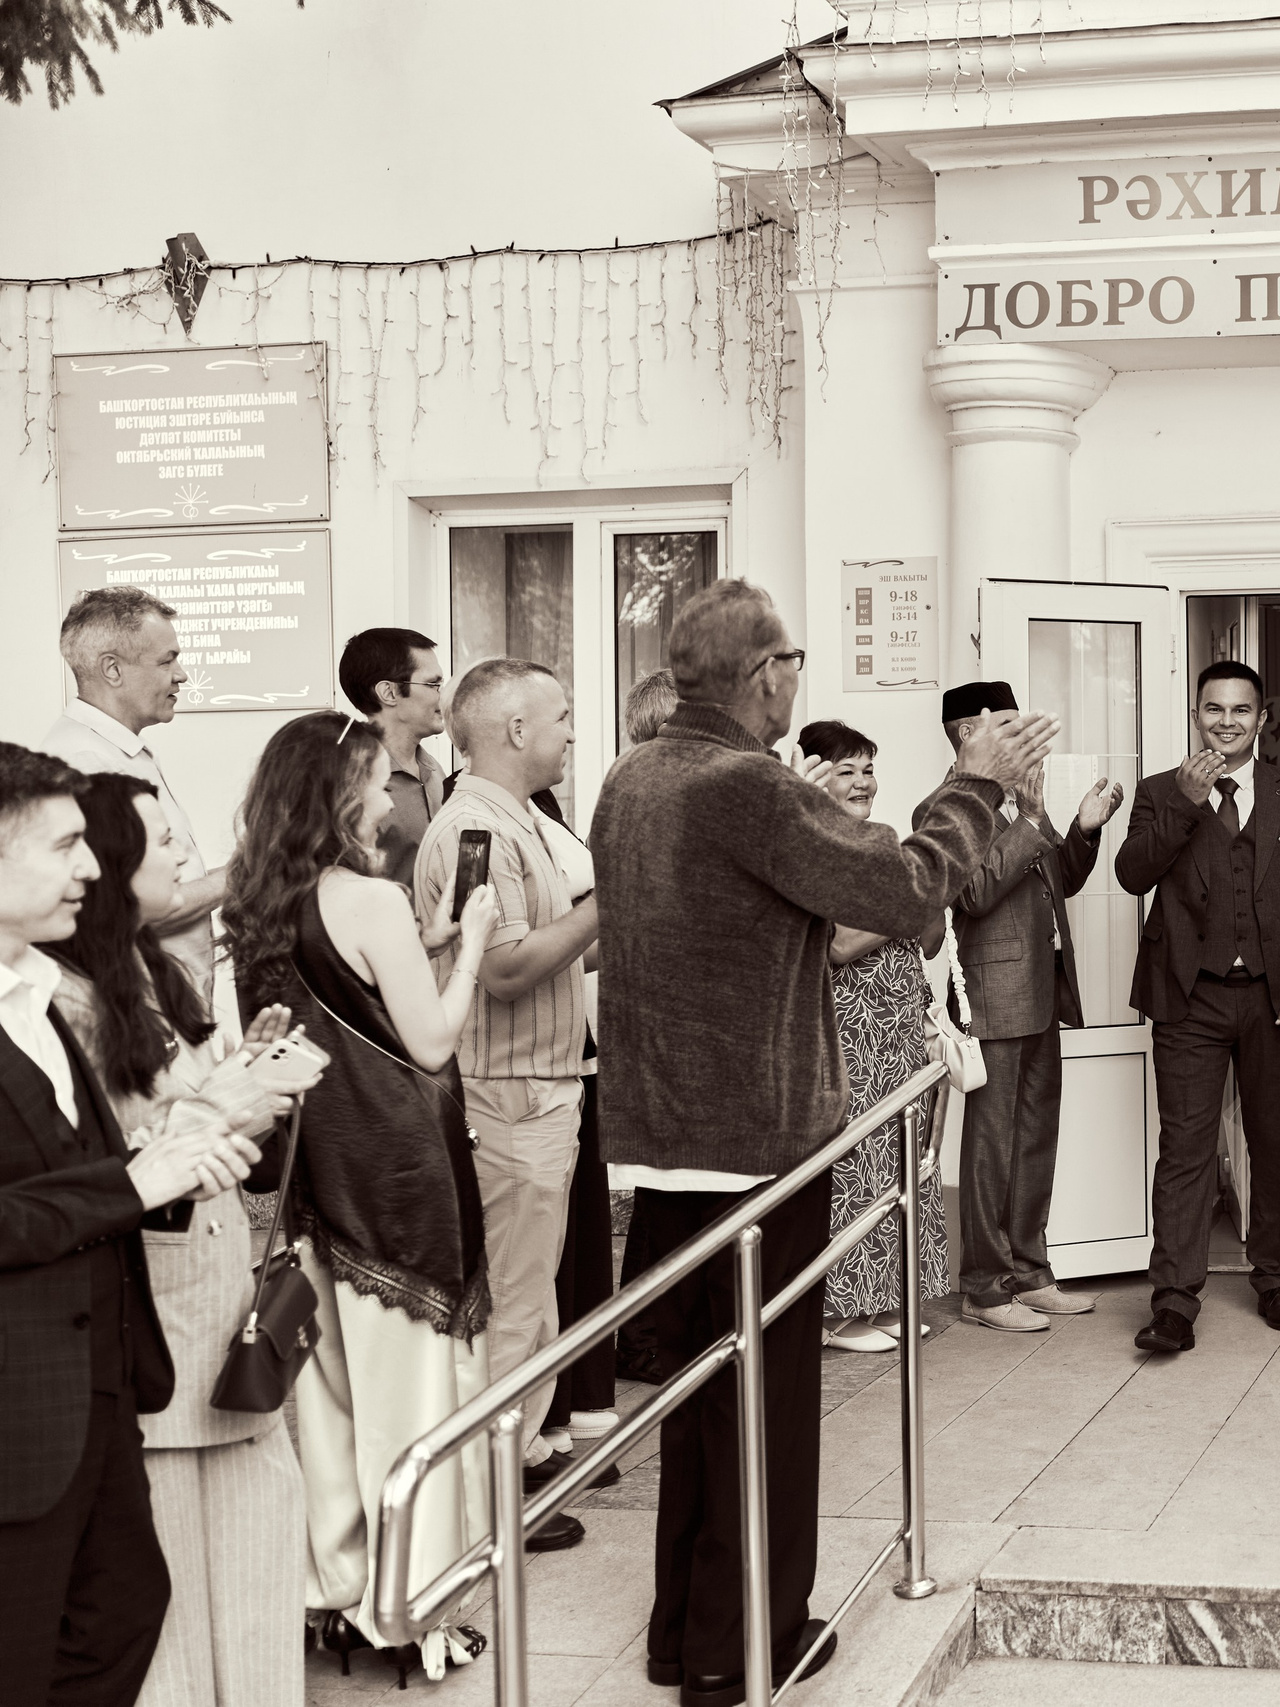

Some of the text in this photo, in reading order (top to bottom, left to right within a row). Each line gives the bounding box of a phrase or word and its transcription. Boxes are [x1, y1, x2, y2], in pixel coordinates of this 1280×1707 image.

[954, 275, 1196, 342] ДОБРО
[99, 396, 185, 413] БАШҠОРТОСТАН
[115, 409, 265, 430] ЮСТИЦИЯ ЭШТӘРЕ БУЙЫНСА
[183, 428, 241, 444] КОМИТЕТЫ
[116, 446, 192, 464] ОКТЯБРЬСКИЙ
[158, 465, 185, 479] ЗАГС
[106, 569, 192, 584] БАШҠОРТОСТАН
[889, 590, 918, 602] 9-18
[892, 611, 918, 621] 13-14
[170, 617, 210, 634] ЮДЖЕТ
[193, 633, 222, 648] БИНА
[889, 630, 918, 642] 9-17
